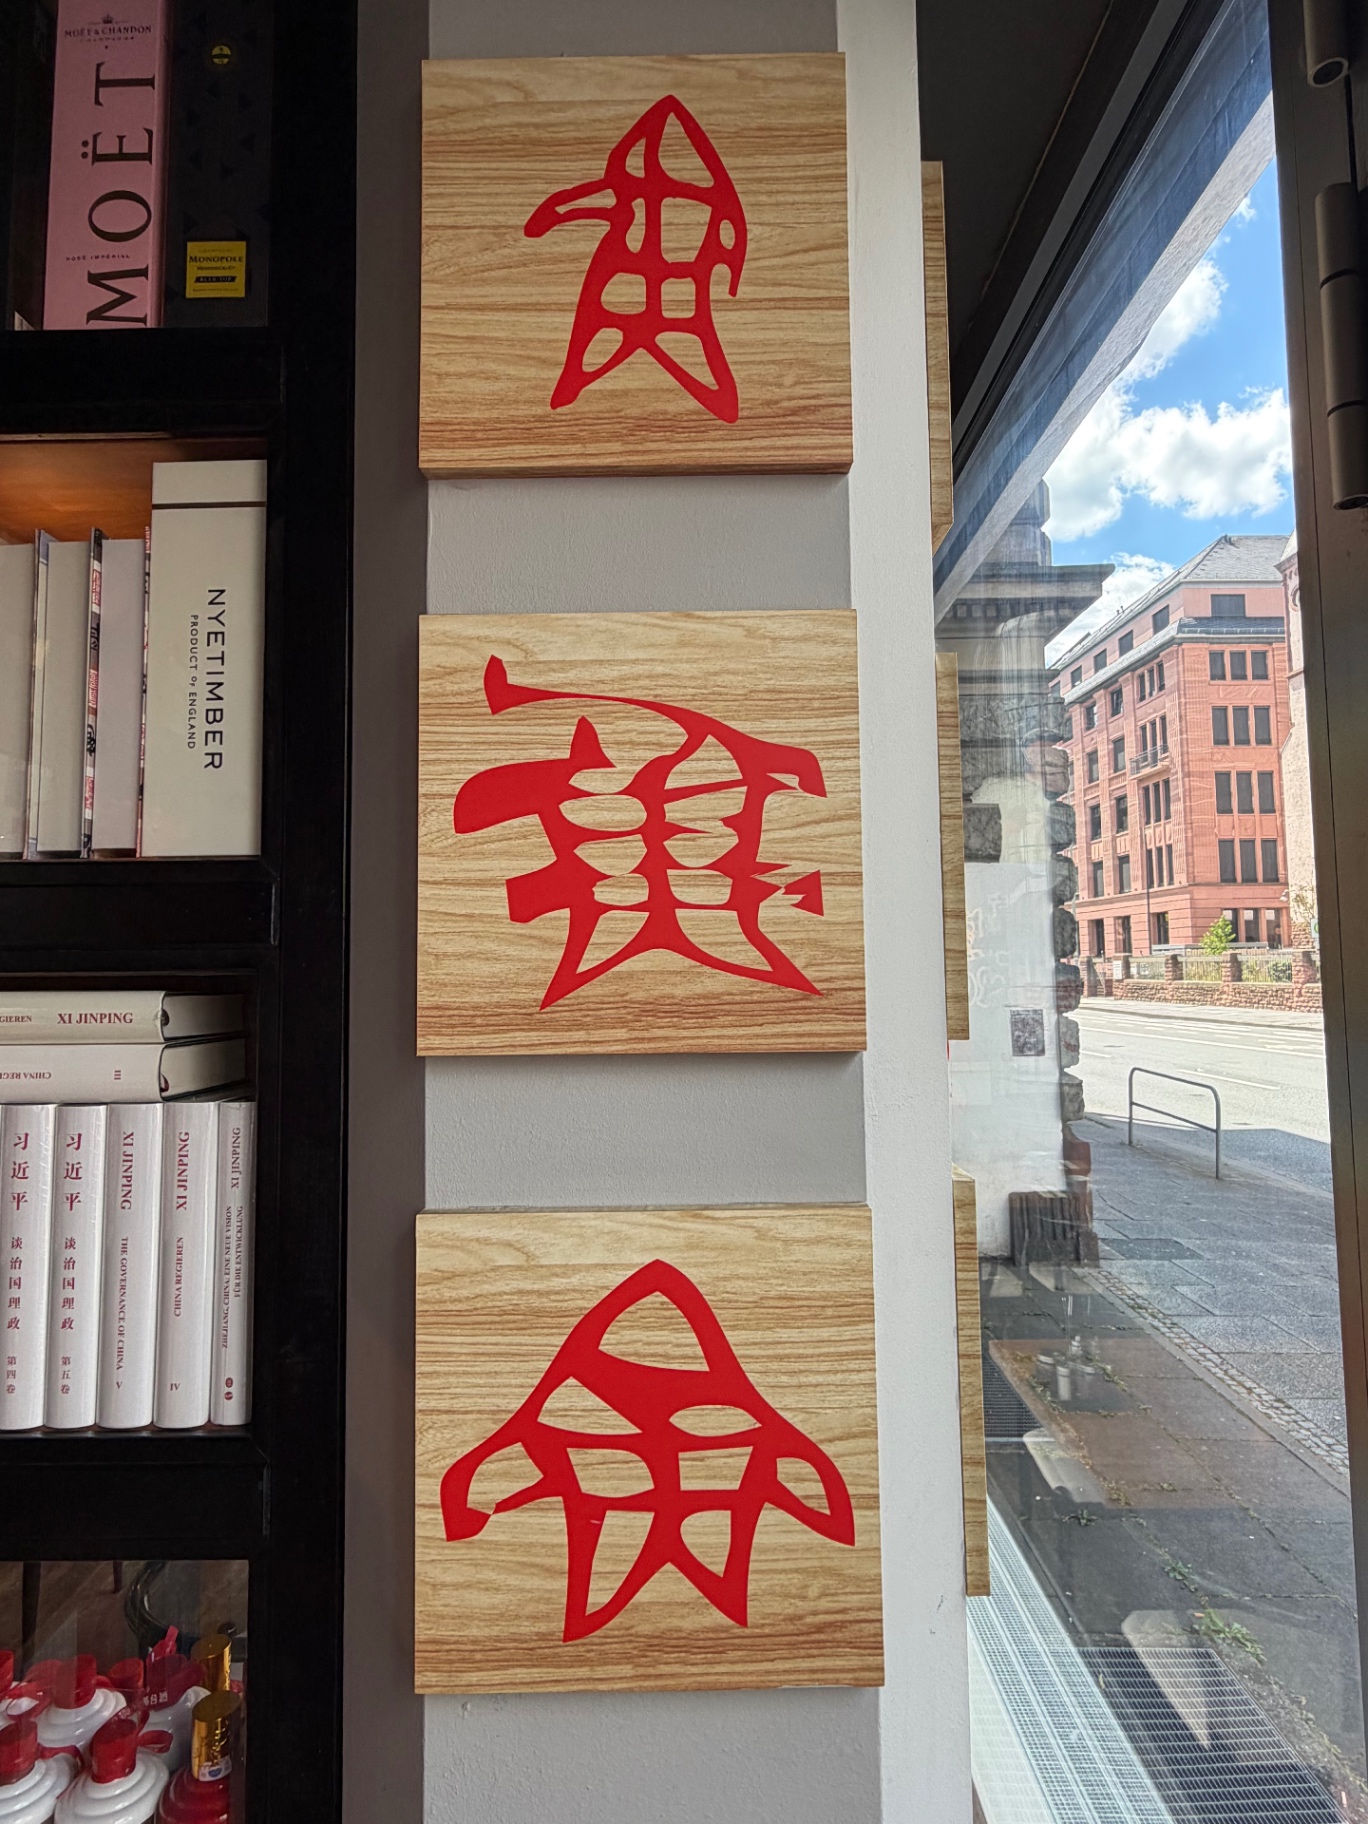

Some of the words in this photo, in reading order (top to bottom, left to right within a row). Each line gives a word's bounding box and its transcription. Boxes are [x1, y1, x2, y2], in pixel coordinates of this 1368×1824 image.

[101, 25, 152, 35] CHANDON
[81, 61, 156, 326] MOËT
[188, 255, 244, 263] MONOPOLE
[189, 614, 199, 671] PRODUCT
[204, 588, 226, 769] NYETIMBER
[187, 692, 197, 750] ENGLAND
[57, 1013, 72, 1025] XI
[75, 1012, 134, 1025] JINPING
[23, 1072, 52, 1080] CHINA
[123, 1131, 135, 1149] XI
[231, 1127, 241, 1174] JINPING
[10, 1132, 30, 1211] 习近平
[63, 1132, 83, 1211] 习近平
[177, 1130, 191, 1190] JINPING
[120, 1151, 134, 1211] JINPING
[230, 1175, 240, 1189] XI
[176, 1193, 188, 1211] XI
[120, 1236, 129, 1256] THE
[234, 1206, 243, 1265] ENTWICKLUNG
[174, 1237, 184, 1285] REGIEREN
[234, 1266, 242, 1280] DIE
[7, 1236, 23, 1330] 谈治国理政
[61, 1237, 76, 1330] 谈治国理政
[118, 1257, 128, 1323] GOVERNANCE
[173, 1286, 182, 1317] CHINA
[233, 1281, 241, 1298] FÜR
[117, 1324, 126, 1338] OF
[116, 1339, 125, 1371] CHINA
[5, 1356, 17, 1394] 第四卷
[60, 1356, 72, 1394] 第五卷
[169, 1382, 181, 1391] IV
